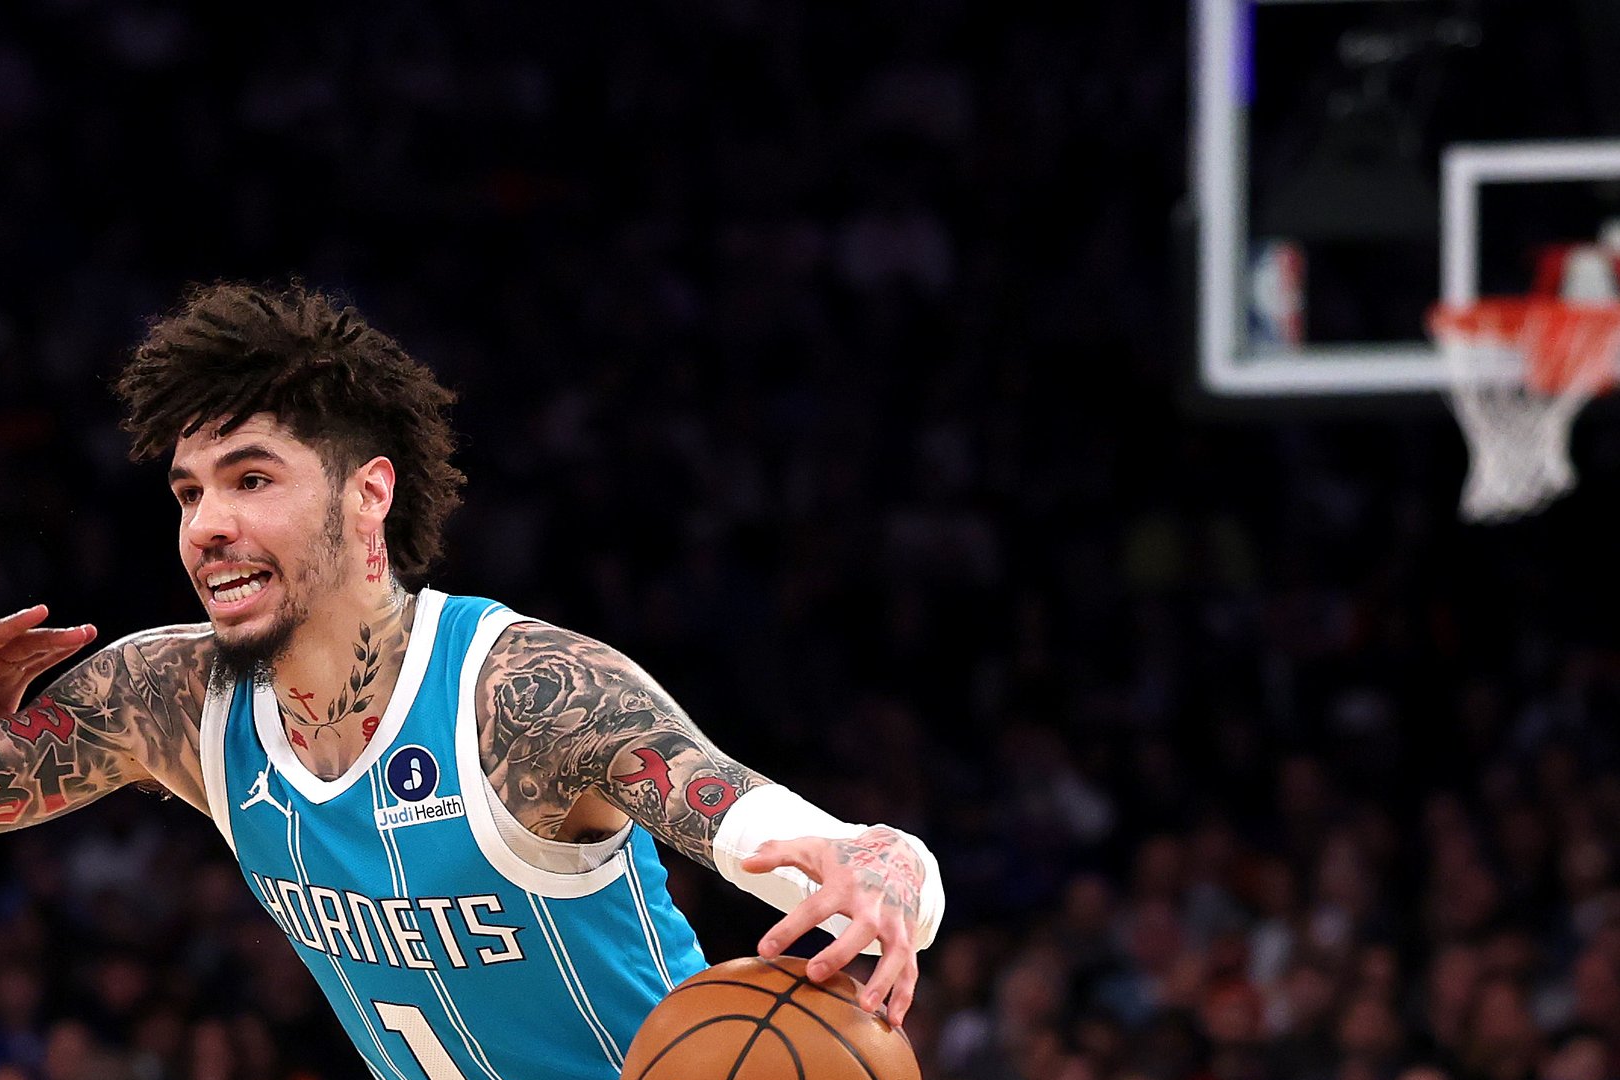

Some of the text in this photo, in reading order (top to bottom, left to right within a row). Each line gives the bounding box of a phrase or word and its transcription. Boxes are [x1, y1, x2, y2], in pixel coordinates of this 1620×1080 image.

[379, 797, 462, 827] Judi Health
[250, 870, 527, 971] HORNETS
